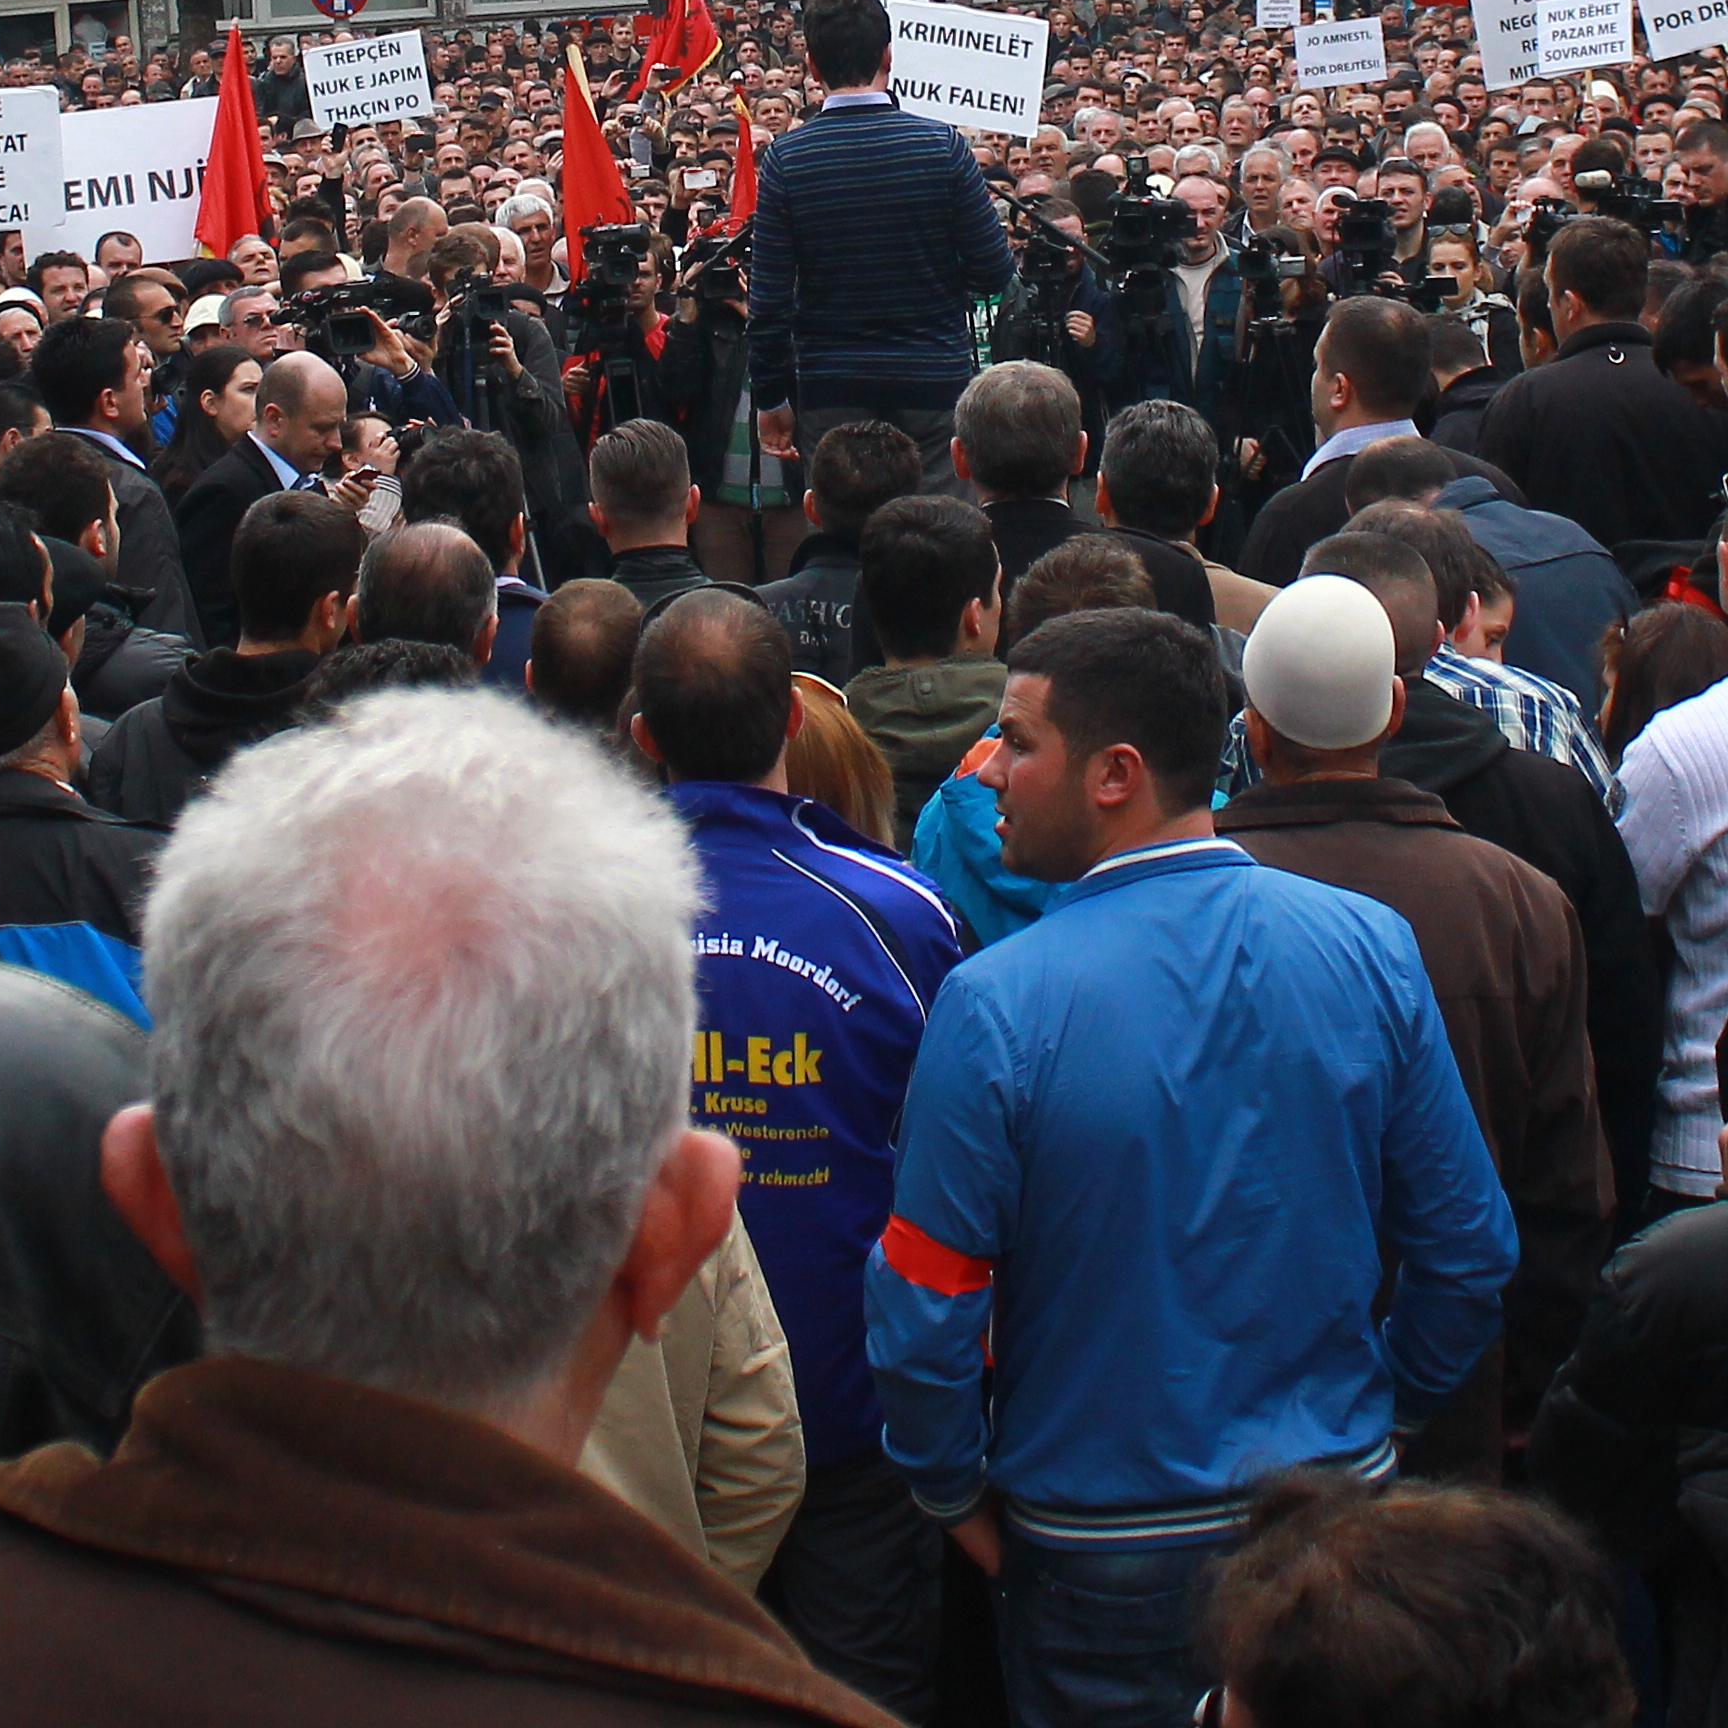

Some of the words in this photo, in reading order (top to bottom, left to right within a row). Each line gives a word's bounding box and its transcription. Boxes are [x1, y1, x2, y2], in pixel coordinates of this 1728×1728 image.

[1548, 9, 1575, 23] NUK
[1579, 3, 1621, 18] BËHET
[1653, 10, 1695, 33] POR
[898, 20, 1034, 59] KRIMINELËT
[1307, 38, 1320, 47] JO
[1551, 26, 1594, 42] PAZAR
[1598, 22, 1618, 35] ME
[323, 41, 401, 67] TREPÇËN
[1544, 40, 1626, 62] SOVRANITET
[313, 78, 350, 97] NUK
[354, 76, 365, 90] E
[370, 66, 422, 88] JAPIM
[1304, 66, 1327, 77] POR
[324, 99, 390, 122] THAÇIN
[395, 94, 419, 111] PO
[892, 77, 943, 103] NUK
[948, 86, 1025, 116] FALEN!
[64, 174, 135, 212] EMI
[693, 932, 744, 956] isia
[750, 934, 862, 1012] Moordorf
[693, 1031, 822, 1087] ll-Eck
[704, 1091, 768, 1115] Kruse
[725, 1122, 829, 1140] Westerende
[758, 1167, 831, 1187] schmeckt
